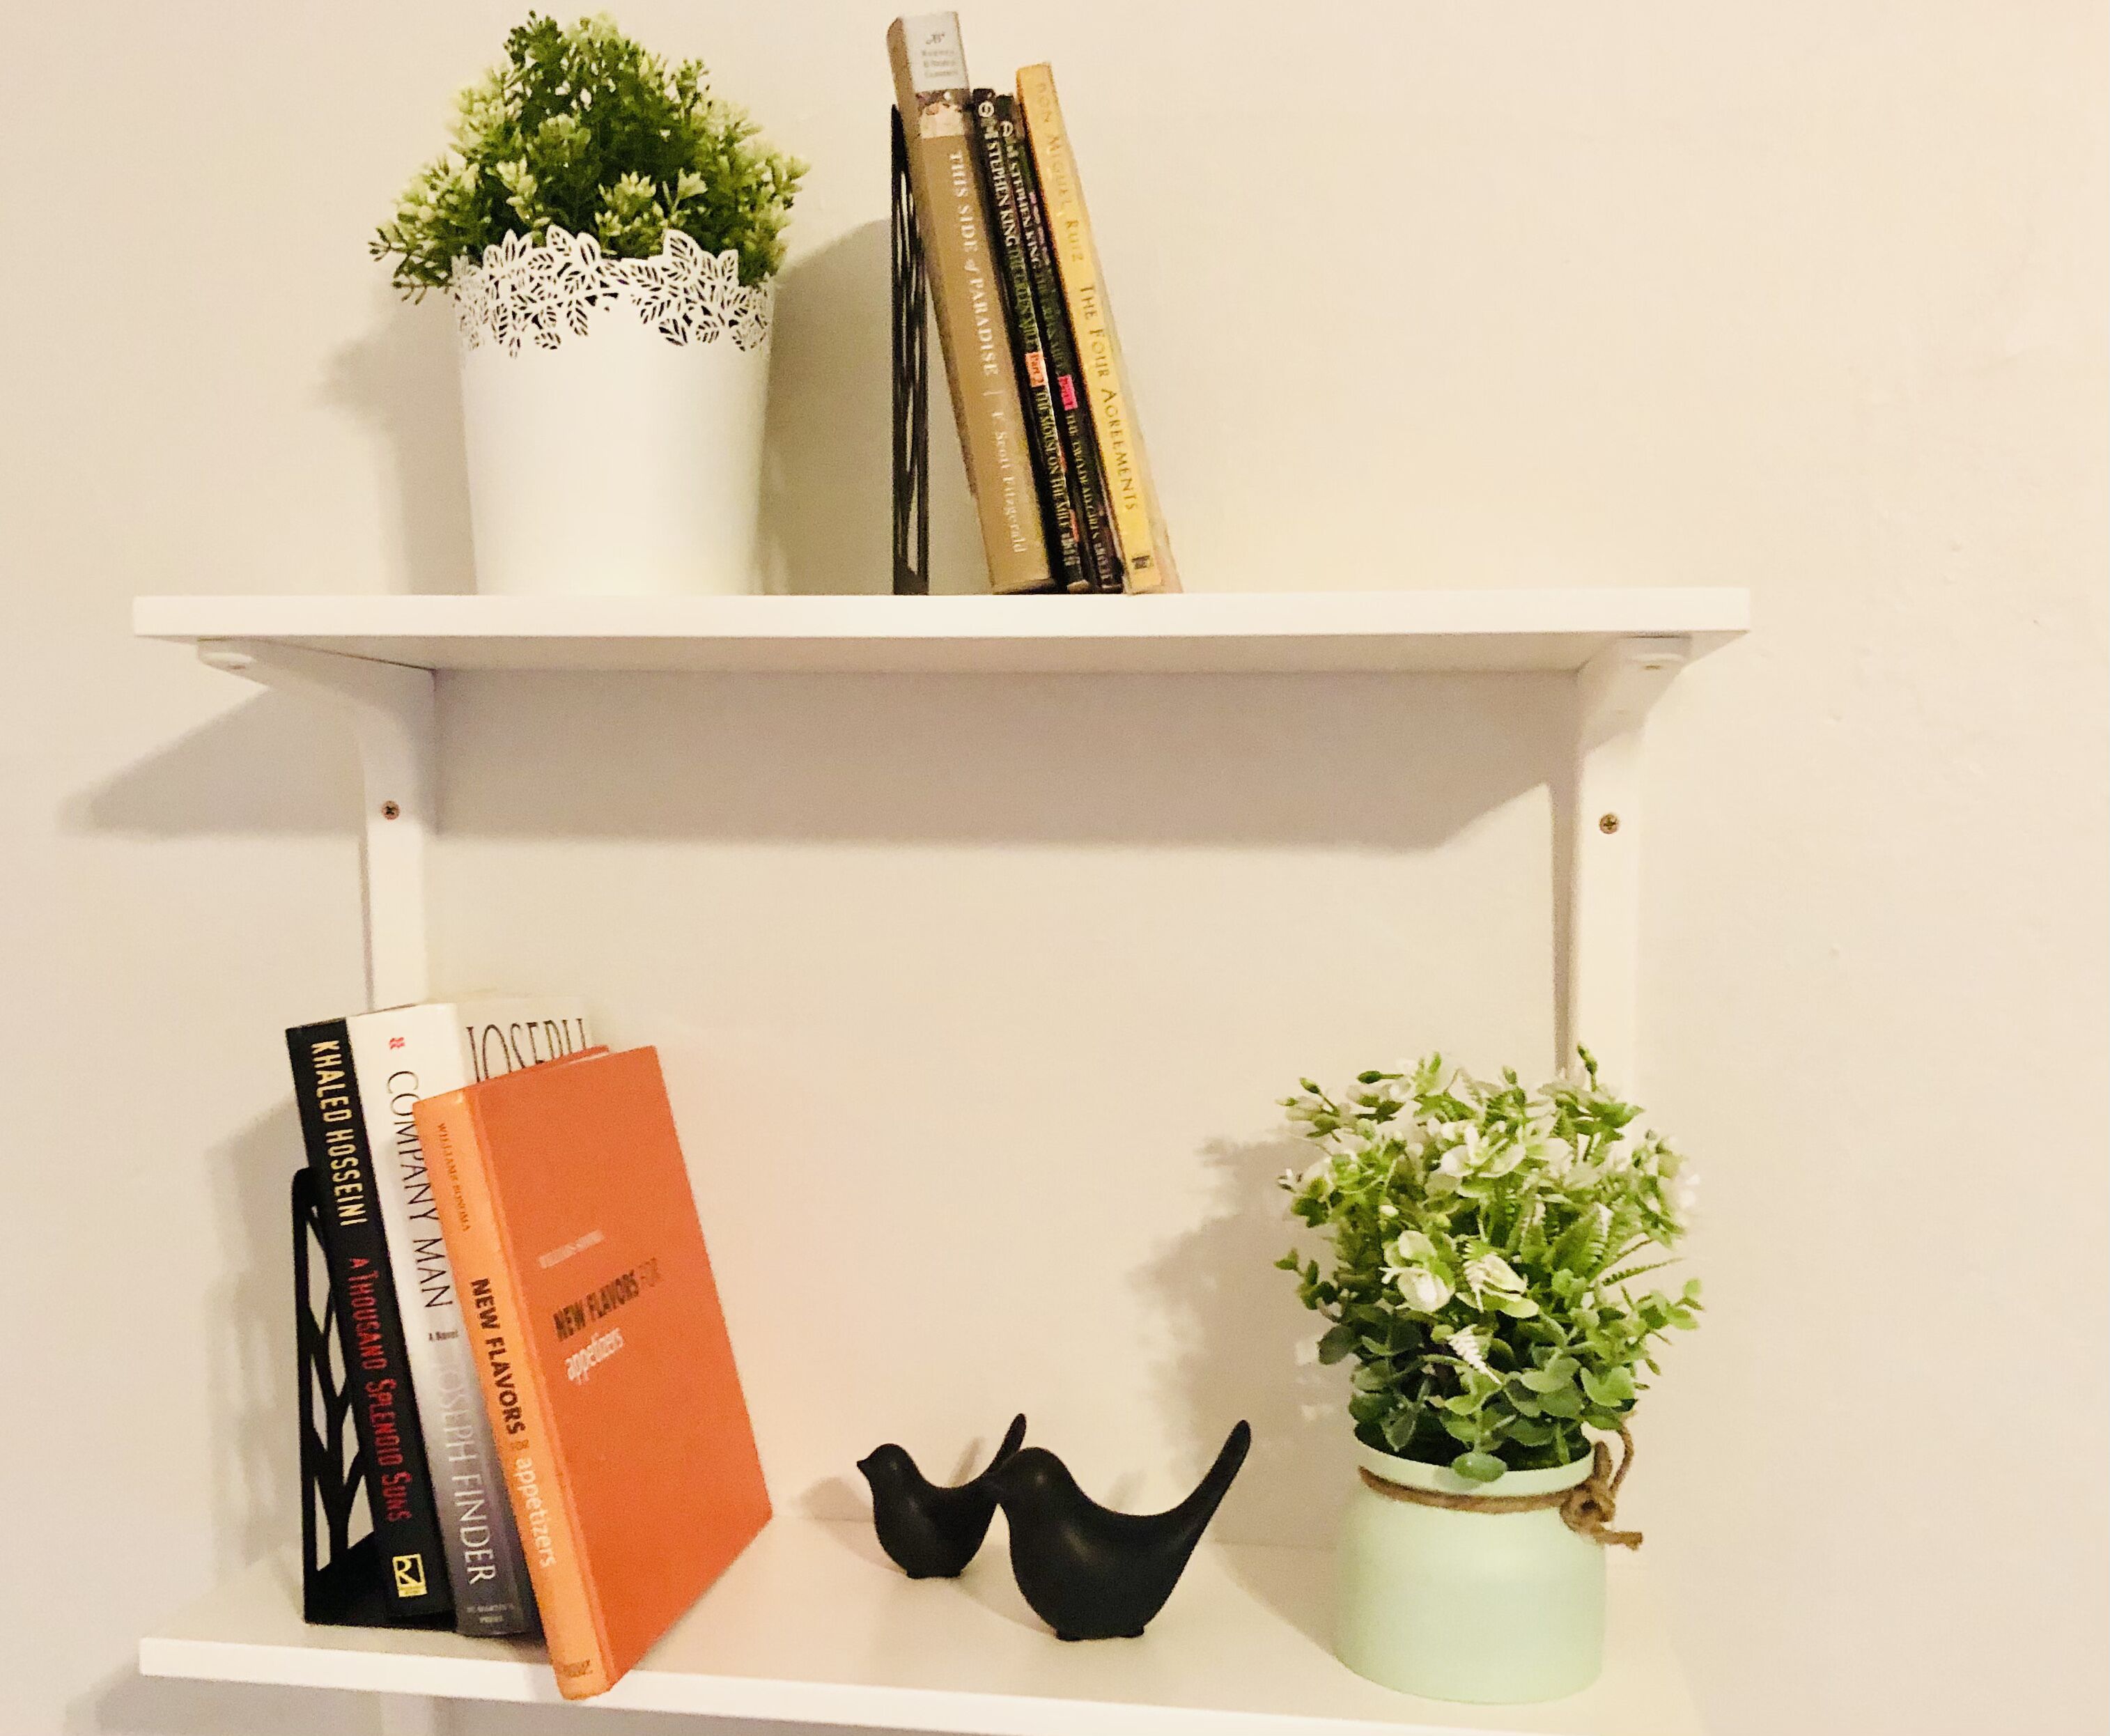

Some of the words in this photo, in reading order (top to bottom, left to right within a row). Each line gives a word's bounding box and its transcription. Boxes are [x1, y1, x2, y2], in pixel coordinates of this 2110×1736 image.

[947, 150, 969, 198] THIS
[986, 141, 1010, 208] STEPHEN
[998, 208, 1019, 247] KING
[956, 204, 979, 253] SIDE
[1008, 162, 1032, 228] STEPHEN
[1024, 228, 1041, 270] KING
[963, 258, 982, 273] of
[1078, 284, 1099, 320] THE
[968, 277, 998, 377] PARADISE
[1088, 328, 1110, 378] FOUR
[993, 431, 1011, 470] Scott
[1038, 415, 1056, 454] MOUSE
[1046, 456, 1060, 474] ON
[1100, 388, 1138, 511] AGREEMENTS
[1001, 476, 1027, 554] Fitzgerald
[310, 1039, 353, 1122] KHALED
[324, 1129, 368, 1227] HOSSEINI
[386, 1070, 440, 1220] COMPANY
[348, 1257, 370, 1269] A
[412, 1237, 453, 1309] MAN
[346, 1269, 389, 1370] THOUSAND
[470, 1277, 502, 1331] NEW
[553, 1299, 587, 1342] NEW
[363, 1378, 404, 1466] SPLENDID
[430, 1363, 476, 1463] OSEPH
[483, 1336, 525, 1435] FLAVORS
[380, 1471, 412, 1523] SUNS
[449, 1473, 496, 1586] FINDER
[512, 1457, 557, 1568] appetizers
